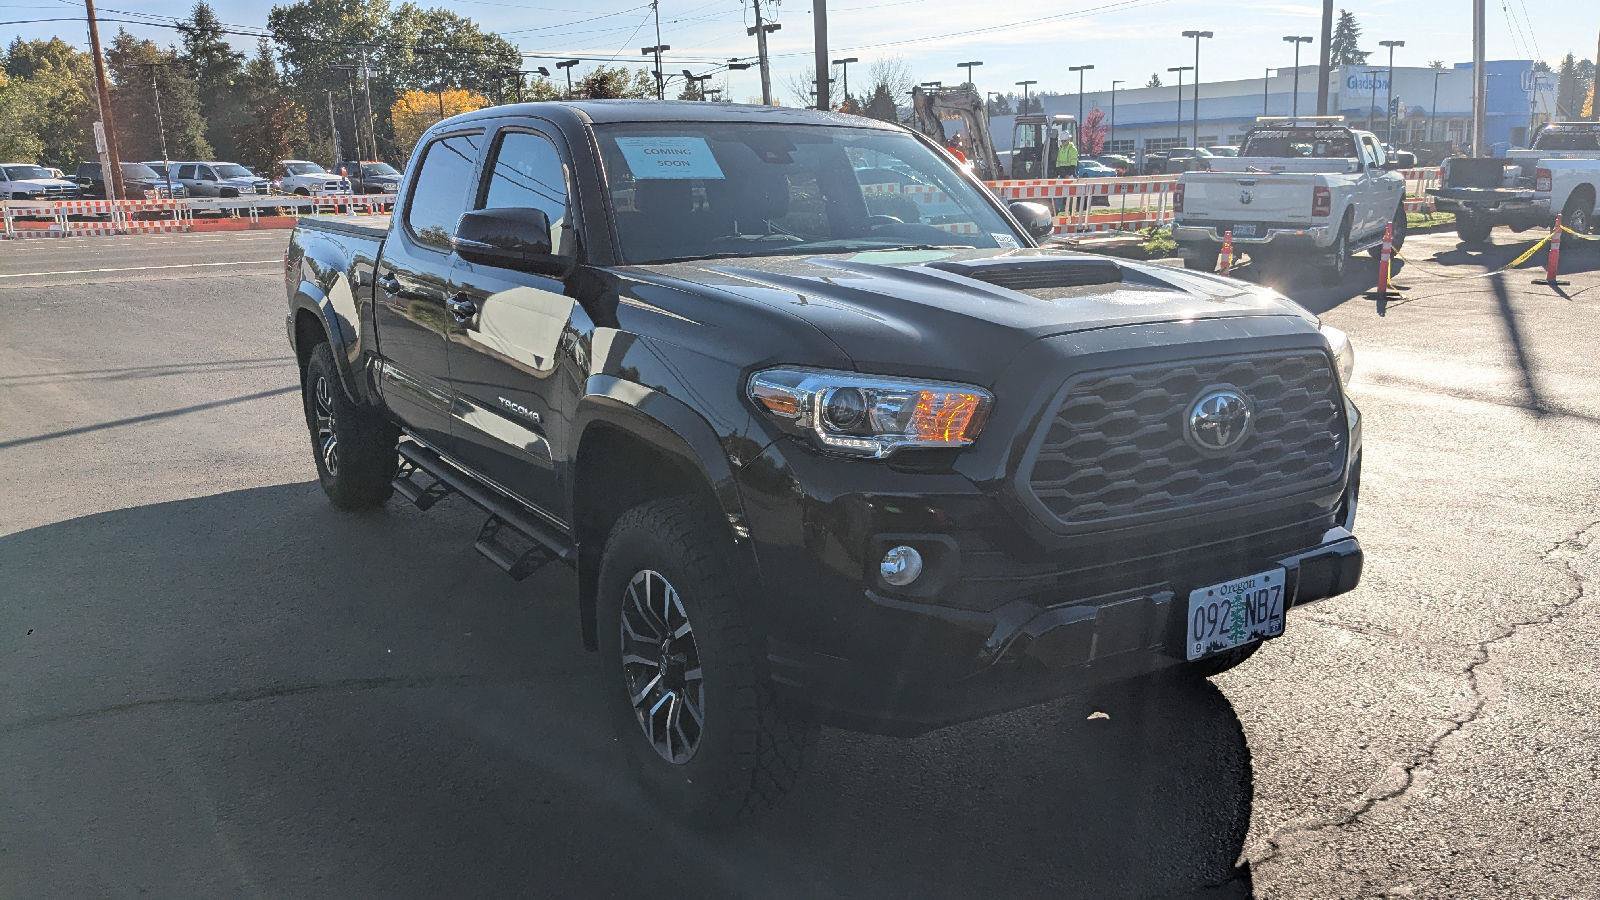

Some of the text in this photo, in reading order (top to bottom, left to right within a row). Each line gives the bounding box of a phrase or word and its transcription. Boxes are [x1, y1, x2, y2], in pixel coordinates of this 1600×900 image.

[643, 148, 692, 156] COMING
[498, 396, 541, 424] TACOMA
[1220, 579, 1257, 596] Oregon
[1193, 585, 1282, 641] 092 NBZ
